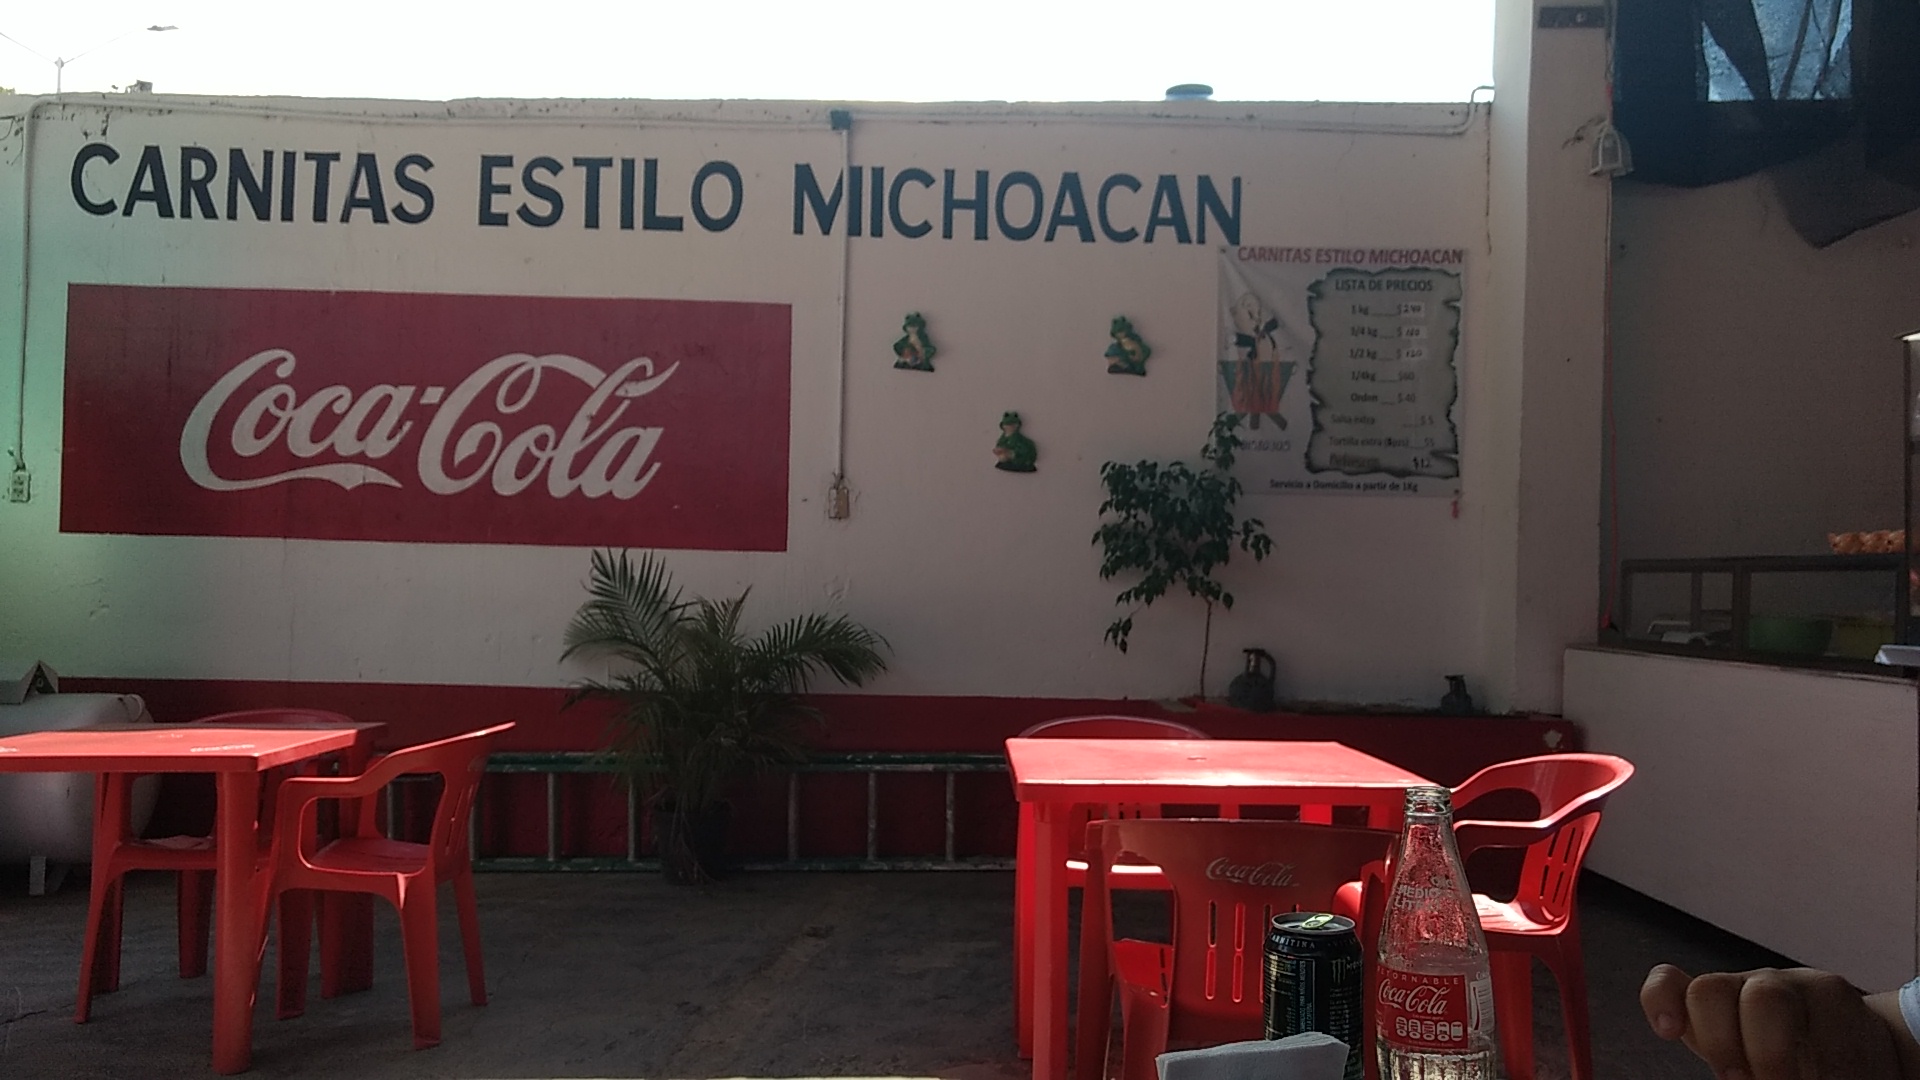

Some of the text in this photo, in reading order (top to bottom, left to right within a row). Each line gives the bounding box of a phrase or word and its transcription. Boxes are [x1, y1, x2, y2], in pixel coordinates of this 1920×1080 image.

[70, 143, 1243, 246] CARNITAS ESTILO MICHOACAN
[1238, 247, 1463, 264] CARNITAS ESTILO MICHOACAN
[1335, 279, 1434, 292] LISTA DE PRECIOS
[1358, 304, 1369, 316] kg
[1350, 392, 1378, 402] Orden
[180, 348, 680, 501] Coca-Cola
[1269, 479, 1304, 489] Servicio
[1305, 481, 1311, 489] a
[1362, 481, 1387, 492] partir
[1389, 482, 1400, 491] de
[1206, 857, 1299, 887] Coca-Cola
[1377, 966, 1459, 985] RETORNABLE
[1378, 978, 1451, 1016] Coca-Cola
